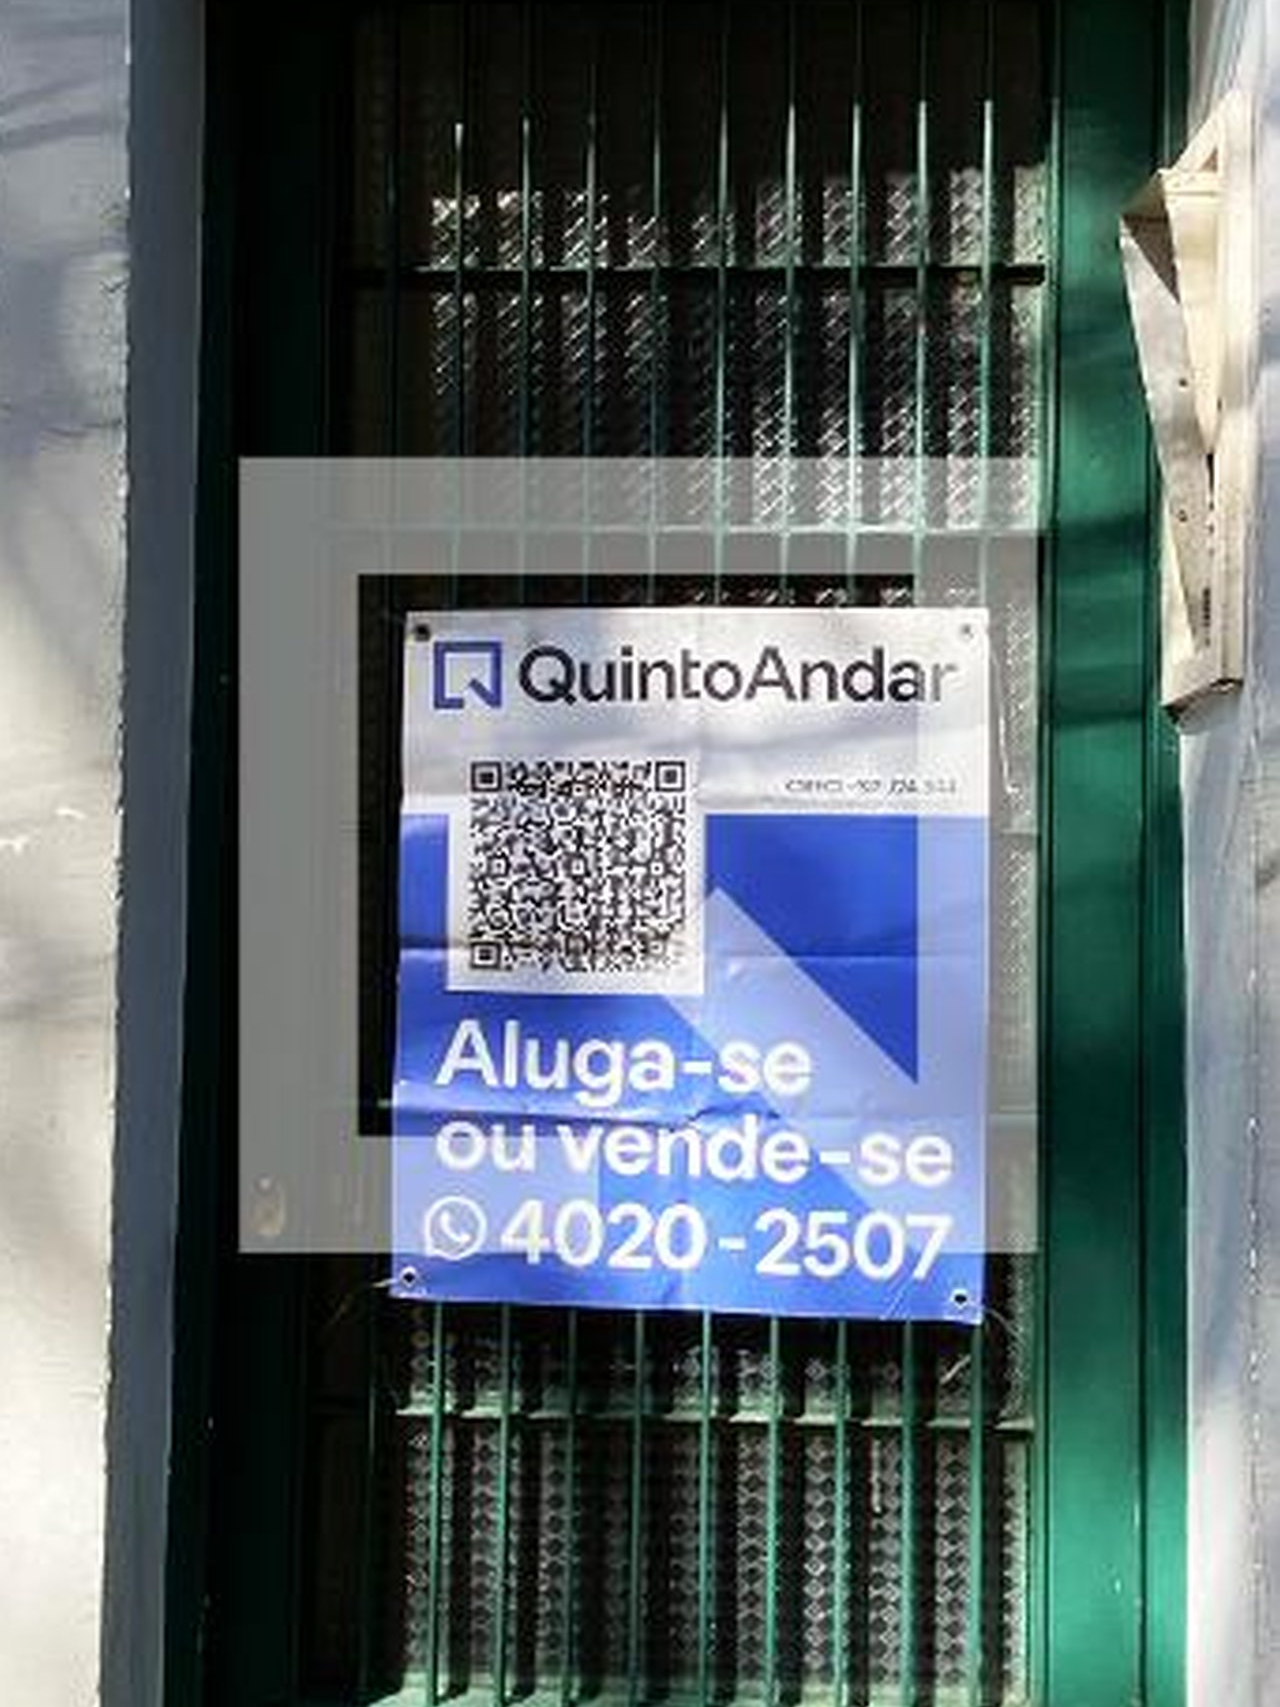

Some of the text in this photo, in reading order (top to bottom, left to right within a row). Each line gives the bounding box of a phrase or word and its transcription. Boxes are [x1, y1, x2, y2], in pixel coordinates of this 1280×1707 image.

[518, 643, 958, 708] QuintoAndar
[435, 1018, 813, 1108] Aluga-se
[435, 1111, 954, 1188] ou vende-se
[499, 1197, 953, 1280] 4020-2507
